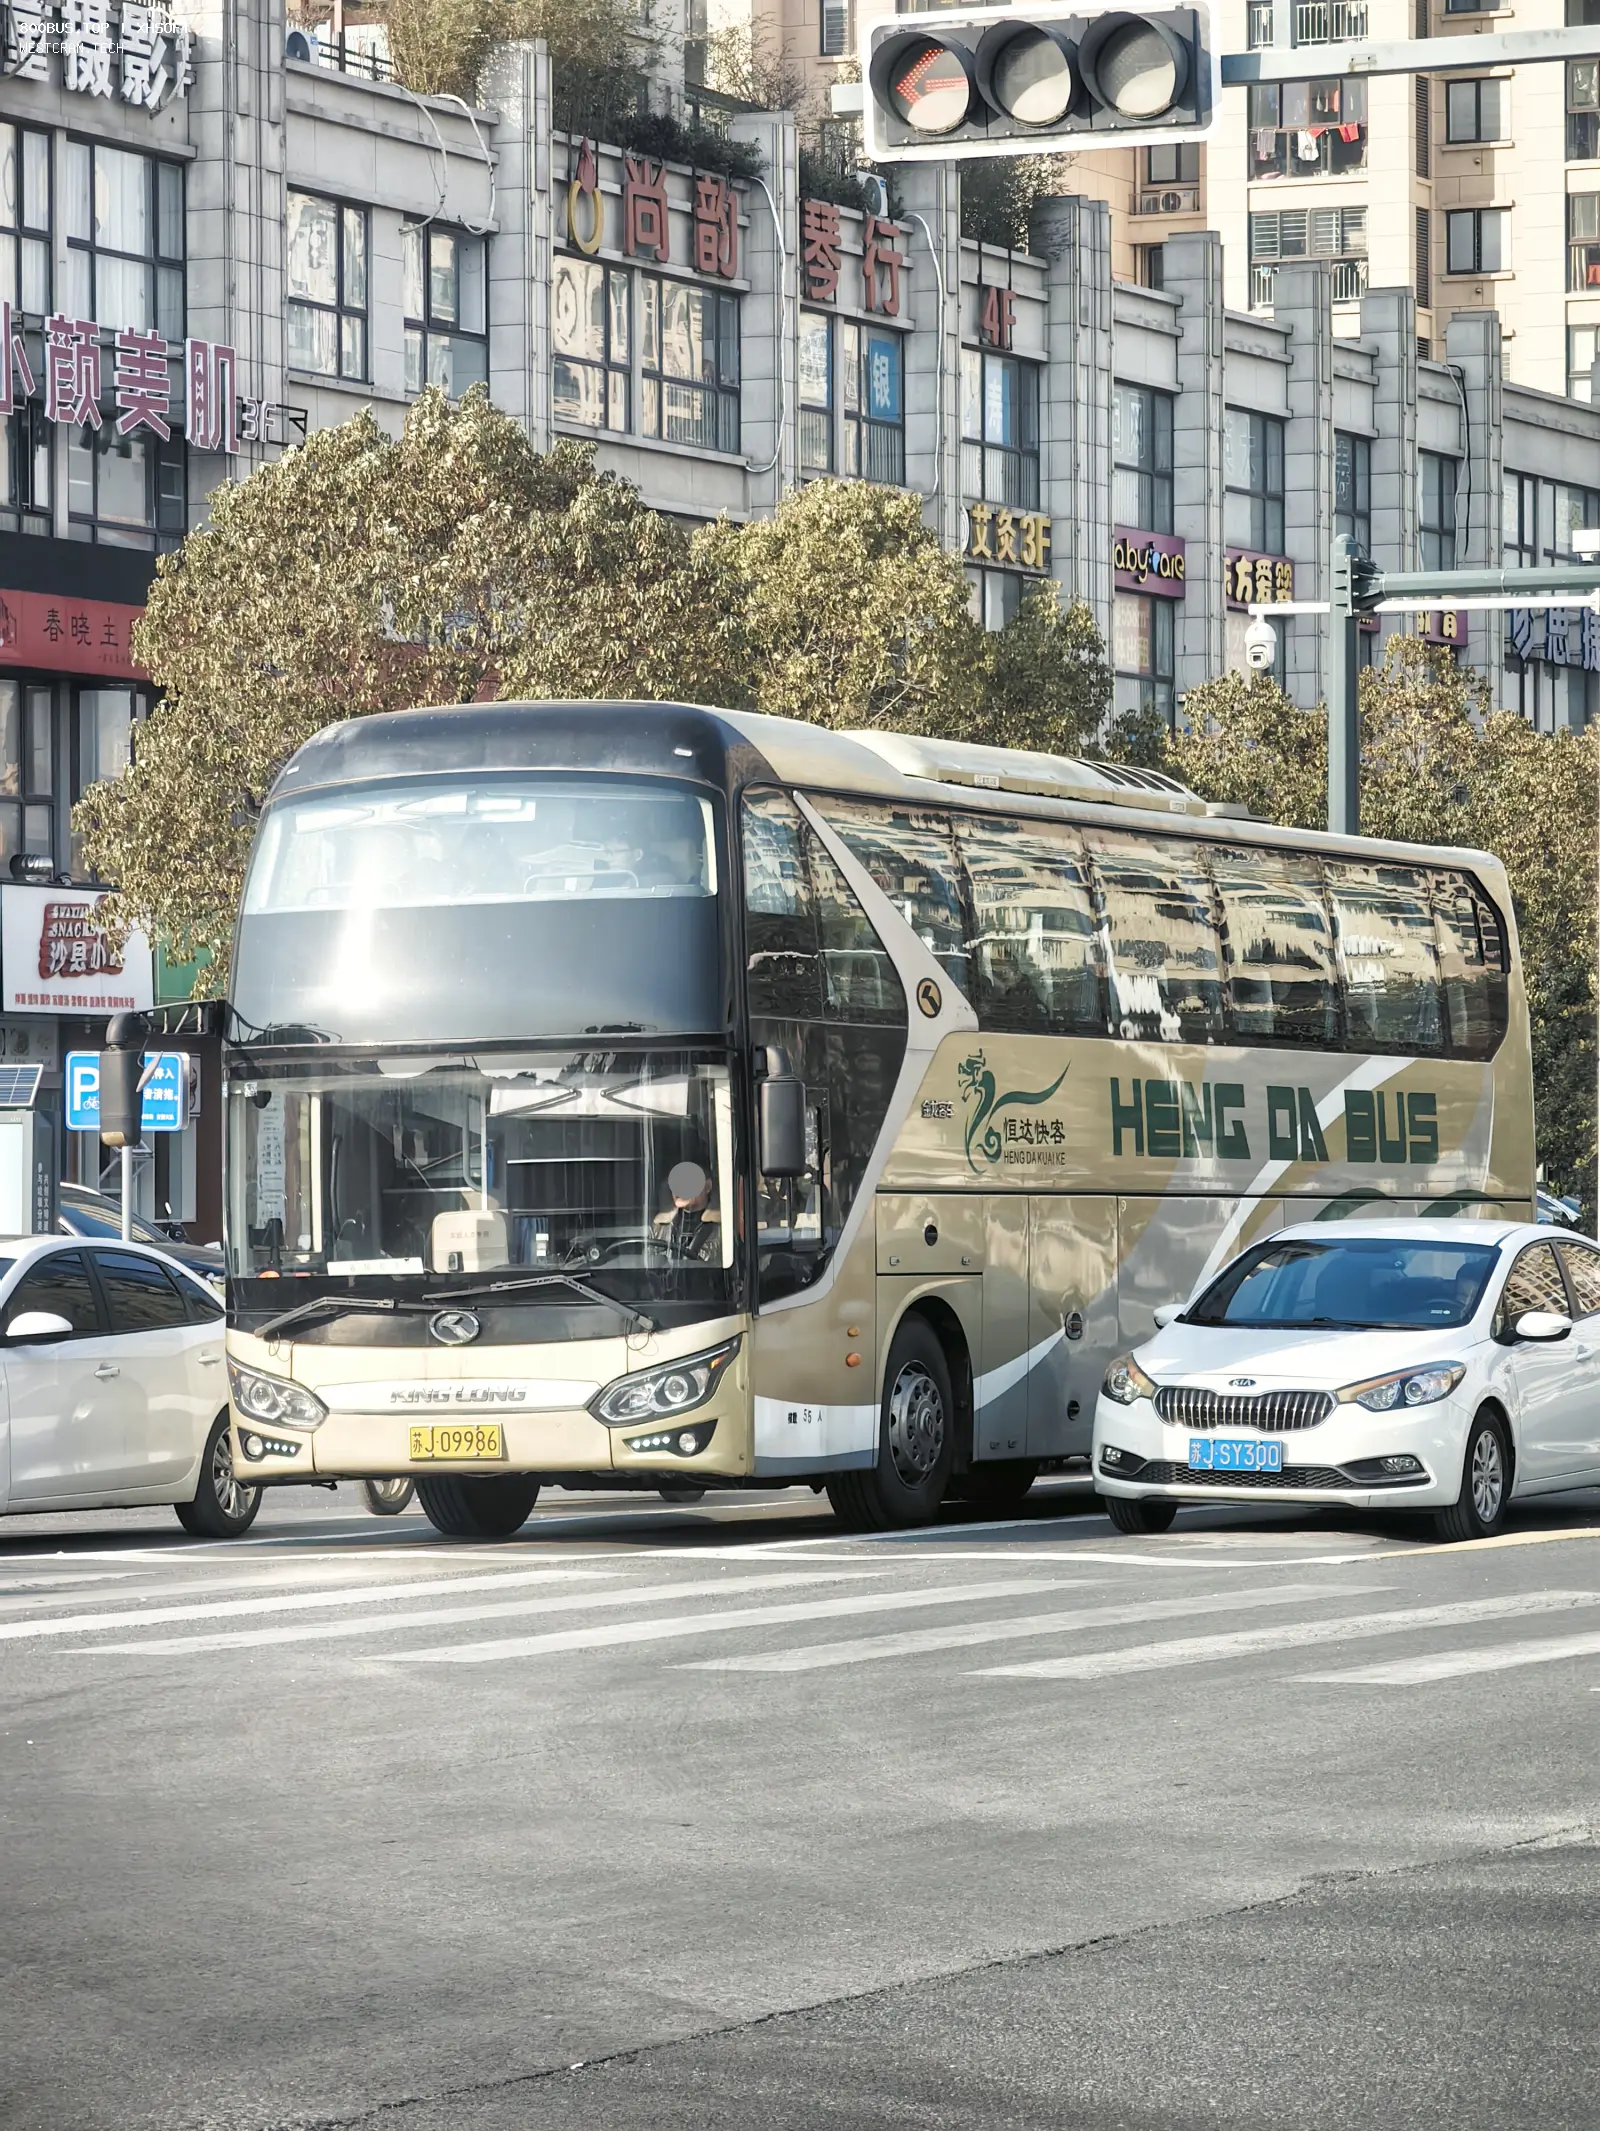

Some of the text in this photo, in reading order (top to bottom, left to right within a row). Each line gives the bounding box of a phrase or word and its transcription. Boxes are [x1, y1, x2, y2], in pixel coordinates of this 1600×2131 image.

[983, 286, 1017, 349] 4F
[243, 397, 277, 443] 3F
[73, 1067, 99, 1111] P
[1003, 1117, 1066, 1145] 恒达快客
[1110, 1076, 1439, 1164] HENG DA BUS
[1003, 1150, 1025, 1165] HENG
[1026, 1151, 1037, 1165] DA
[1055, 1152, 1066, 1166] KE
[390, 1386, 452, 1403] KING
[1231, 1378, 1253, 1387] KIA
